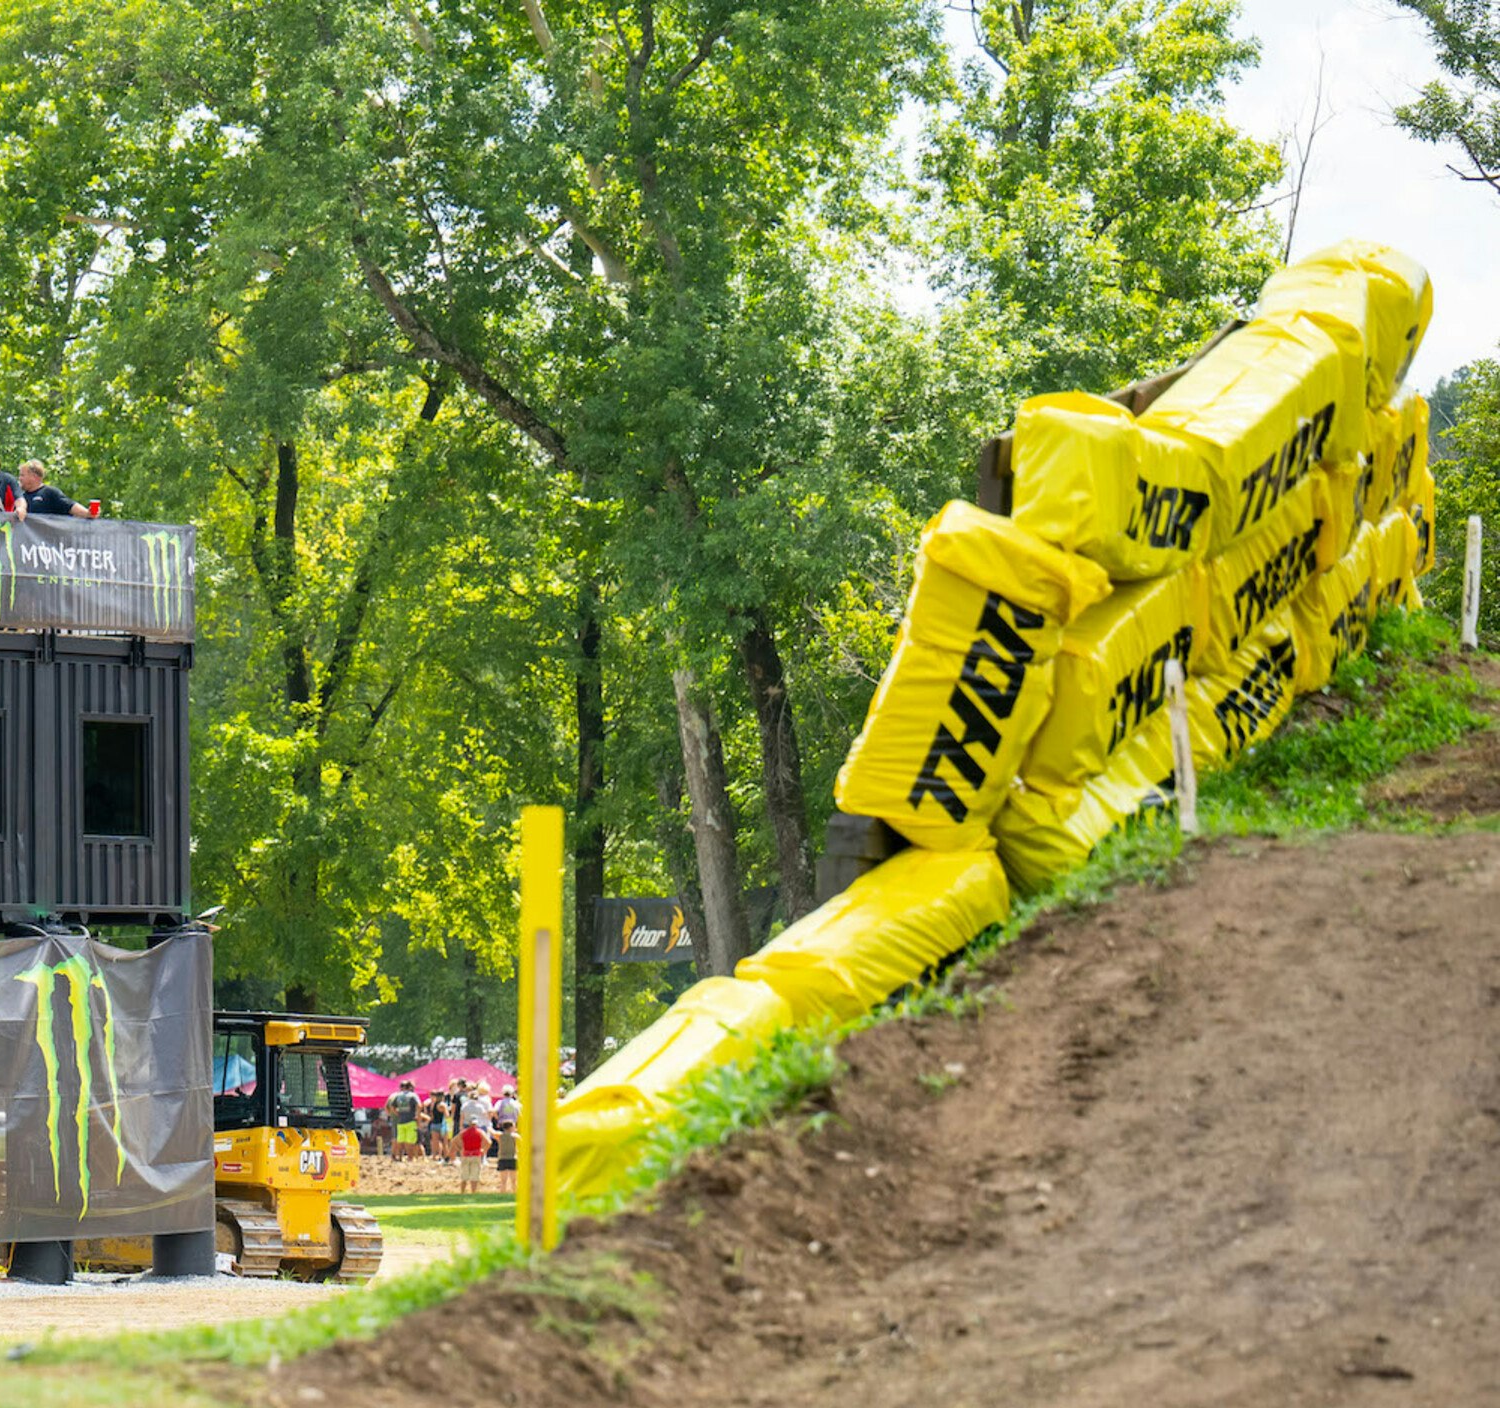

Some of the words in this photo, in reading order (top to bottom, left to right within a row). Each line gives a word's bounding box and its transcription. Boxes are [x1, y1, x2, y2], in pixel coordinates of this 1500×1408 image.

[20, 541, 117, 573] MONSTER
[37, 575, 102, 587] ENERGY
[907, 590, 1045, 823] THOR
[300, 1151, 323, 1174] CAT
